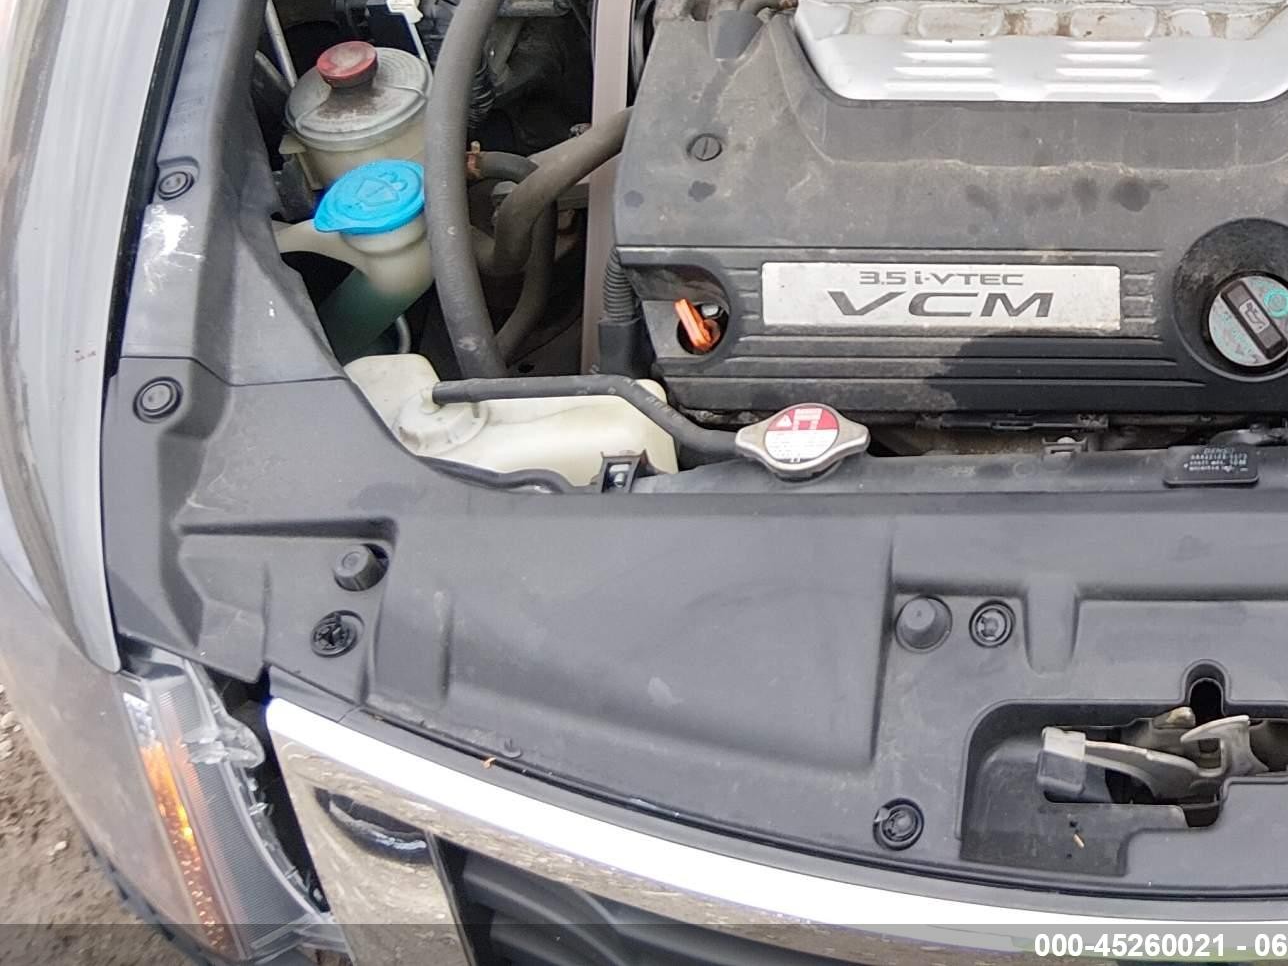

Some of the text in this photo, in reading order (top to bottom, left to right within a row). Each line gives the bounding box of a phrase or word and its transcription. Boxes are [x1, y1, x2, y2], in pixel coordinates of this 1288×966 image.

[859, 270, 1024, 286] 3.5 i-VTEC
[827, 290, 1055, 318] VCM
